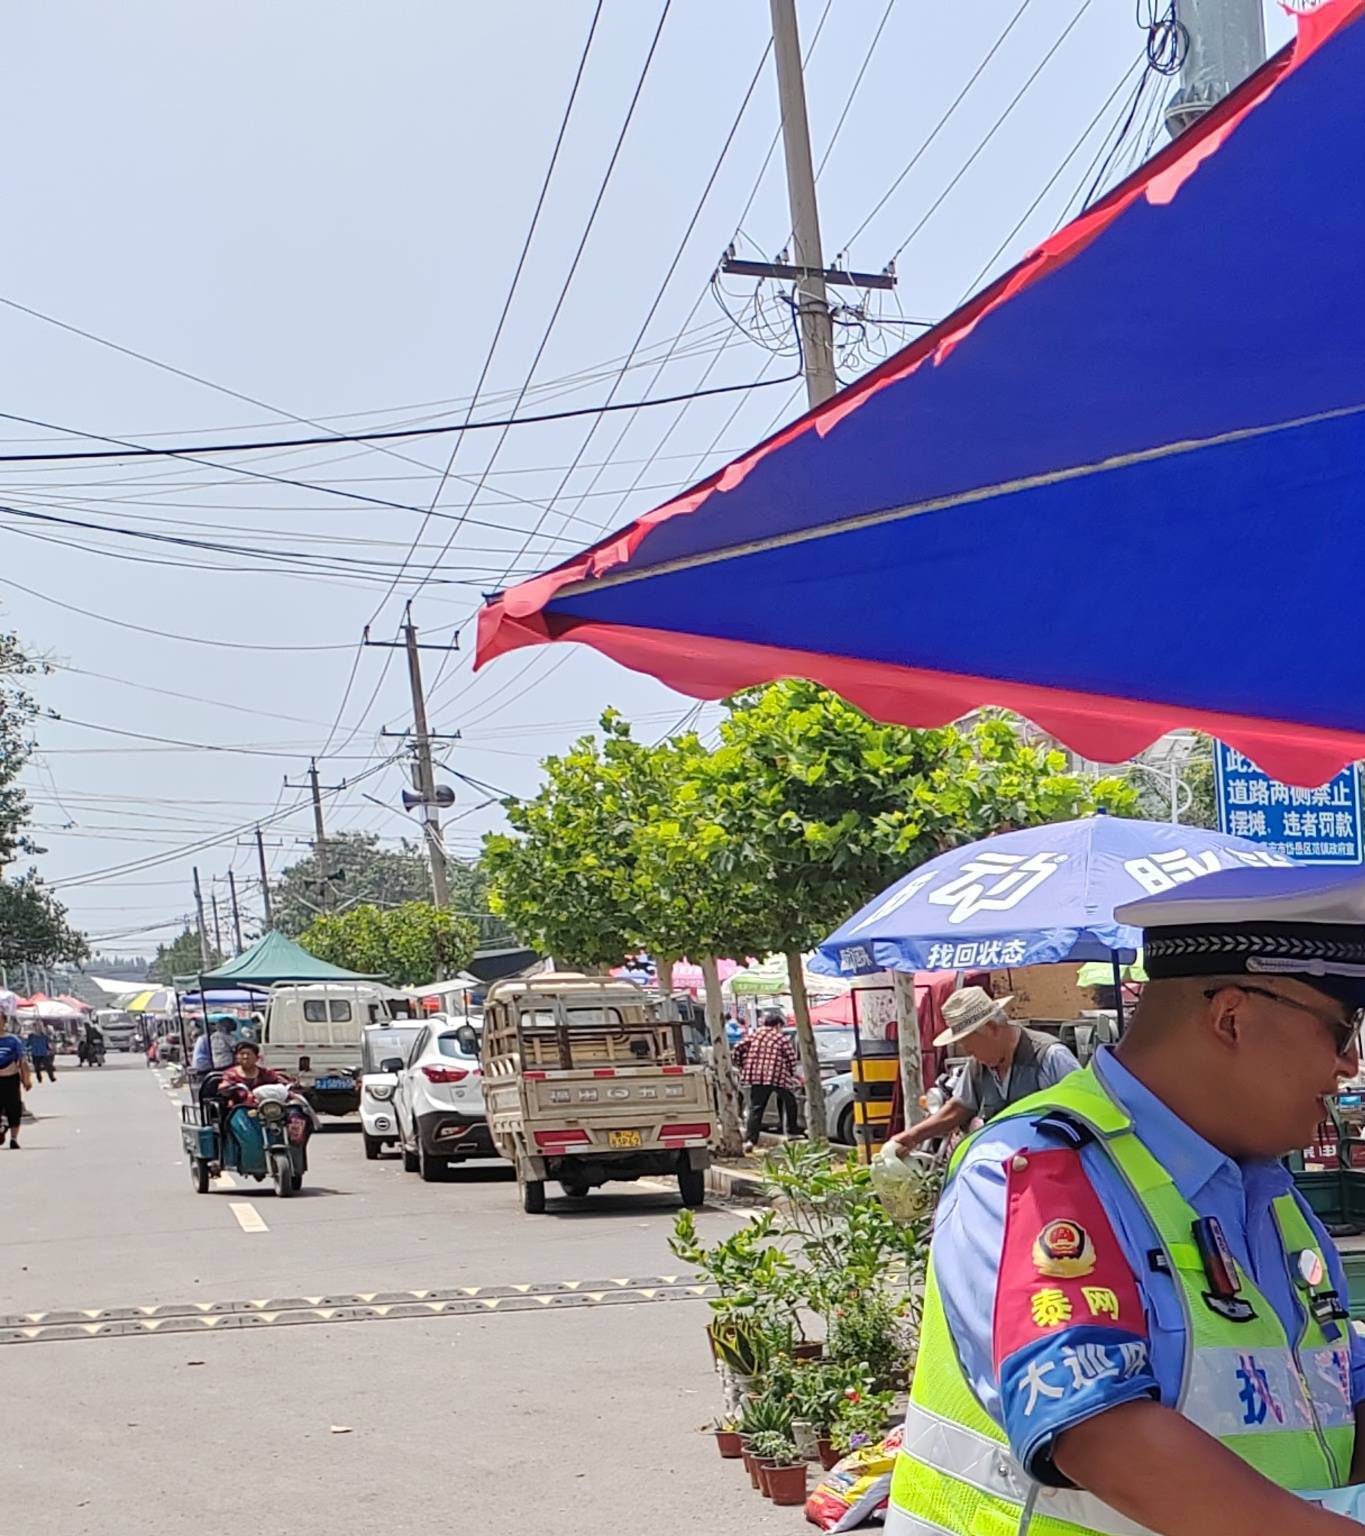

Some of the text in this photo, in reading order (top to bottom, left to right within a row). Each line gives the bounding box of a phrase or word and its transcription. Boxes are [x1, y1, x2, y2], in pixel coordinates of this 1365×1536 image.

[1227, 779, 1352, 806] 道路两侧禁止
[926, 939, 1027, 969] 找回状态
